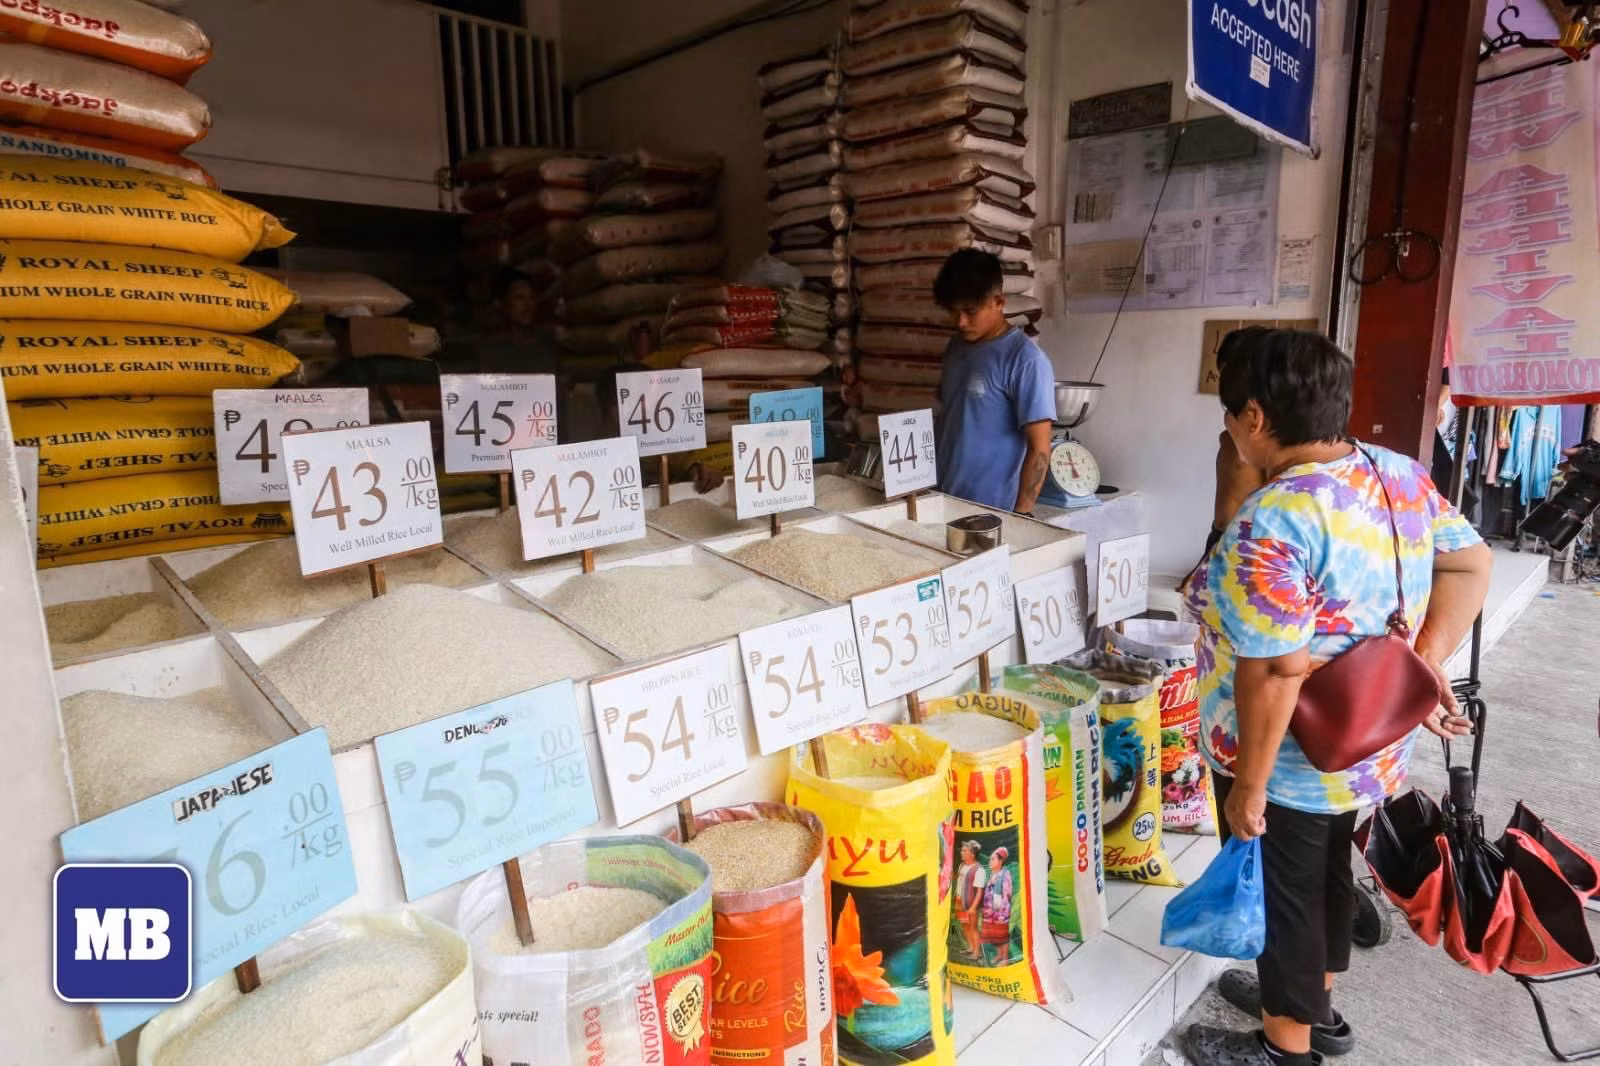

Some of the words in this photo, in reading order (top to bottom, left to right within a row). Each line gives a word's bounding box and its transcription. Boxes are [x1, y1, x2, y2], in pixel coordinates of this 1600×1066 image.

[1247, 0, 1311, 48] Cash
[1211, 2, 1272, 62] ACCEPTED
[1274, 46, 1300, 82] HERE
[0, 136, 127, 167] NANDOMENG
[0, 171, 49, 183] AL
[53, 175, 138, 190] SHEEP
[57, 202, 115, 215] GRAIN
[119, 207, 177, 222] WHITE
[181, 212, 218, 226] RICE
[19, 256, 118, 271] ROYAL
[126, 262, 204, 278] SHEEP
[44, 287, 116, 298] WHOLE
[120, 288, 175, 301] GRAIN
[179, 292, 232, 307] WHITE
[236, 299, 270, 312] RICE
[16, 336, 118, 348] ROYAL
[124, 336, 202, 347] SHEEP
[43, 362, 115, 374] WHOLE
[119, 361, 174, 373] GRAIN
[178, 361, 231, 373] WHITE
[235, 365, 271, 377] RICE
[480, 383, 528, 392] MALAMBOT
[275, 393, 324, 404] MAALSA
[48, 429, 110, 446] WHITE
[116, 427, 171, 440] GRAIN
[346, 436, 391, 450] MAALSA
[79, 453, 163, 470] SHEEP
[471, 453, 505, 463] Premium
[557, 447, 608, 462] MALAMBOT
[39, 507, 104, 525] WHITE
[110, 500, 165, 515] GRAIN
[162, 517, 245, 534] ROYAL
[70, 527, 154, 547] SHEEP
[329, 542, 353, 554] Well
[355, 533, 386, 549] Milled
[387, 529, 408, 542] Rice
[410, 522, 433, 536] Local
[547, 536, 568, 547] Well
[569, 529, 595, 545] Milled
[596, 526, 614, 538] Rice
[641, 674, 677, 692] BROWN
[1086, 711, 1100, 774] RICE
[650, 776, 681, 797] Special
[1076, 748, 1086, 811] PANDAN
[971, 805, 1013, 829] RICE
[1185, 811, 1207, 822] RICE
[1077, 813, 1088, 873] COCO
[673, 984, 699, 1024] BEST
[784, 979, 806, 1033] Rice
[498, 1009, 539, 1023] special!
[677, 999, 701, 1032] SELLER
[727, 1017, 768, 1029] LEVELS
